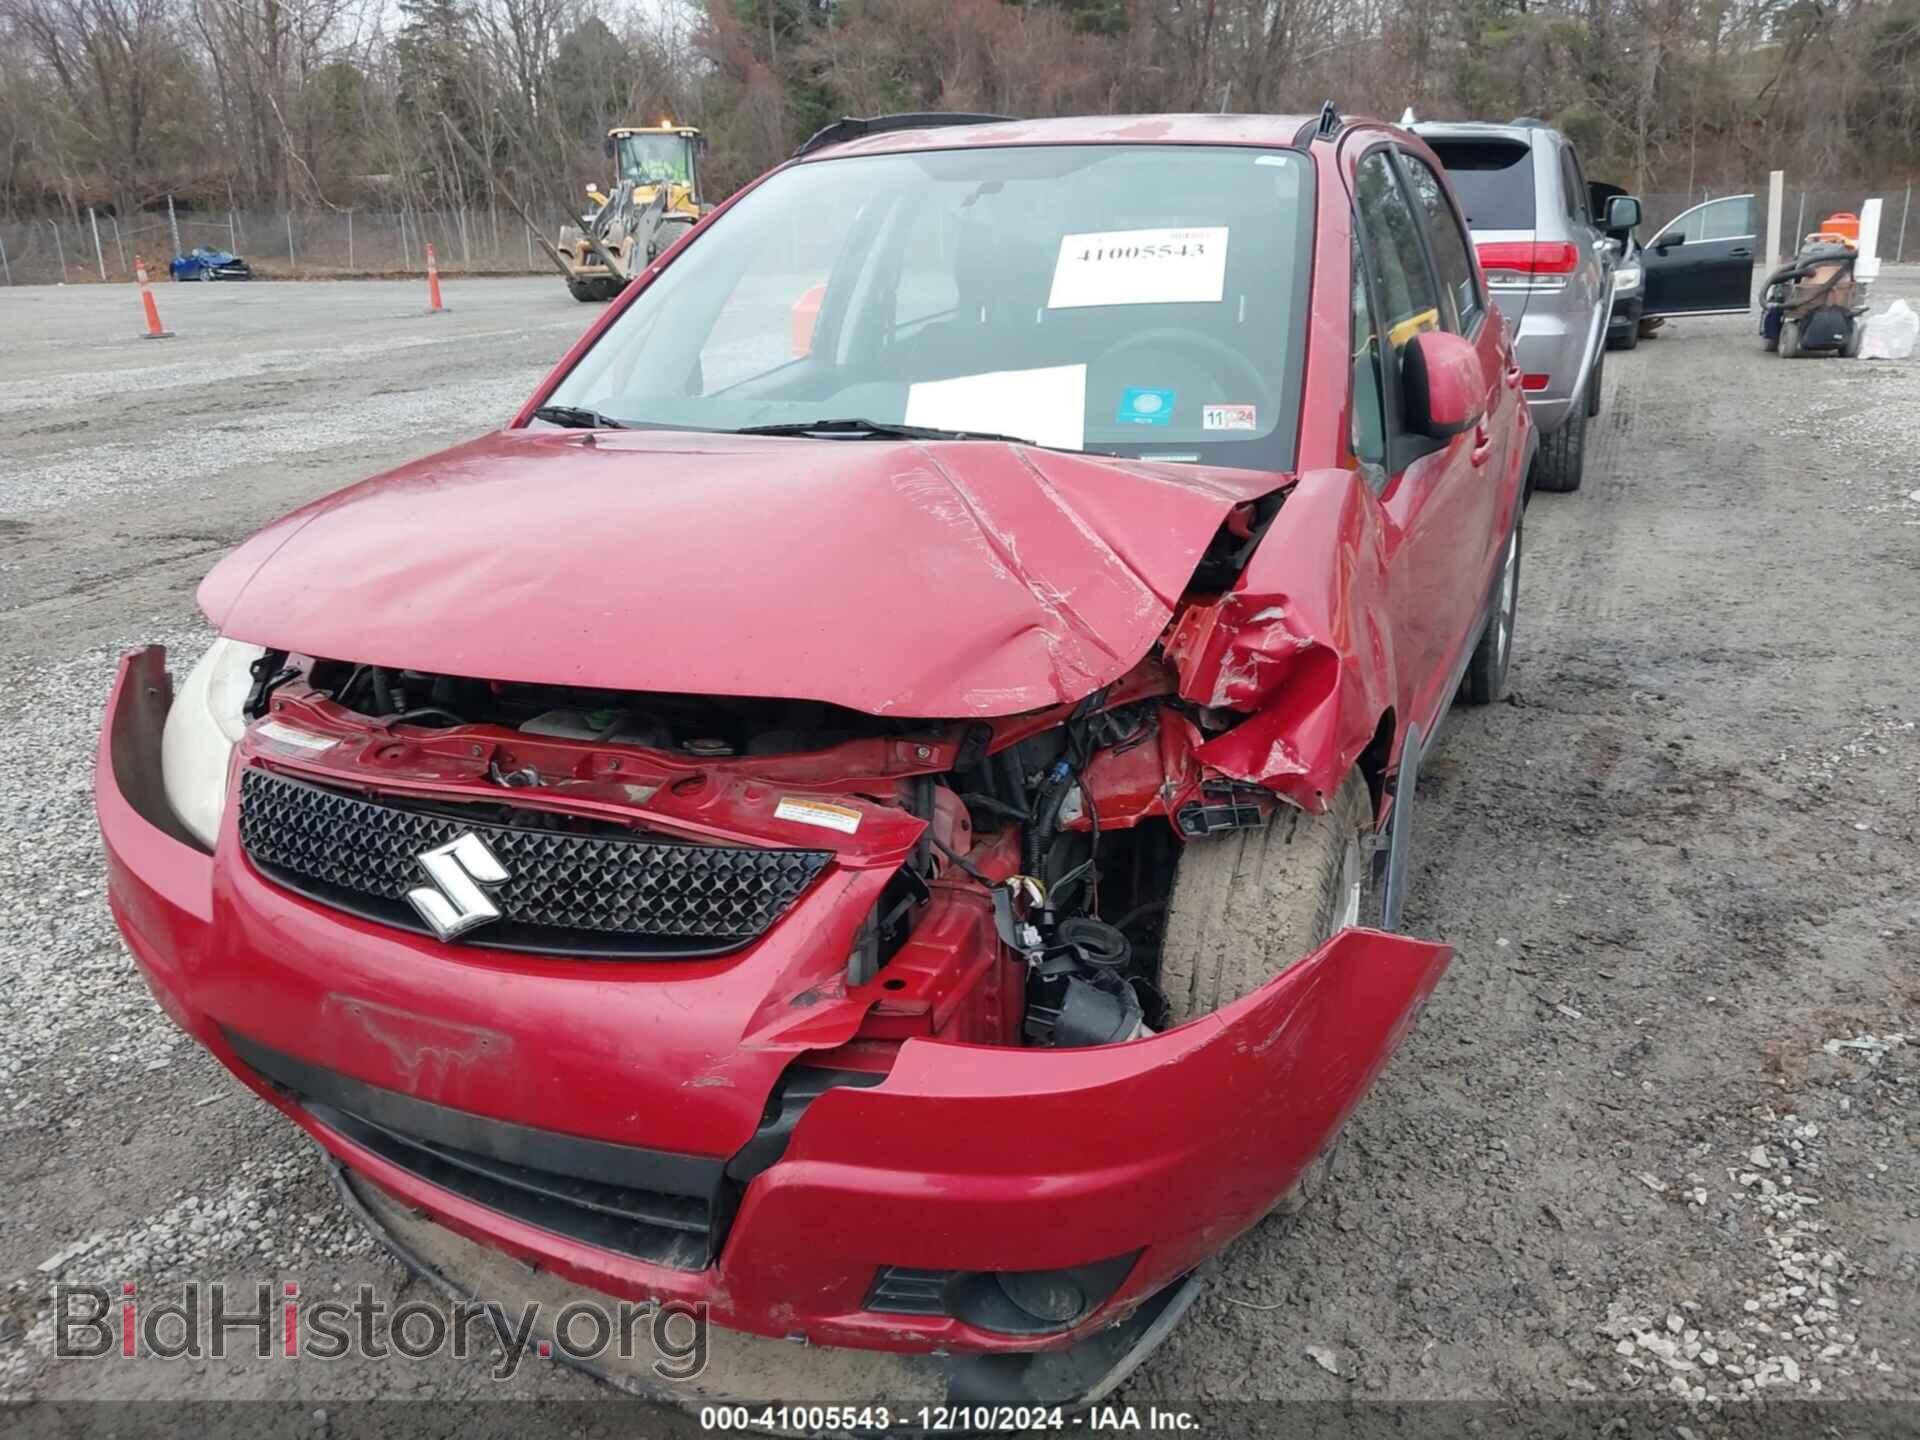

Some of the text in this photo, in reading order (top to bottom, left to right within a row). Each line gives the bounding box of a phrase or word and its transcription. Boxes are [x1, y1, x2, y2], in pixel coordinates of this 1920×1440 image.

[1075, 244, 1205, 263] 41005543
[1207, 411, 1223, 426] 11
[1238, 410, 1253, 422] 24
